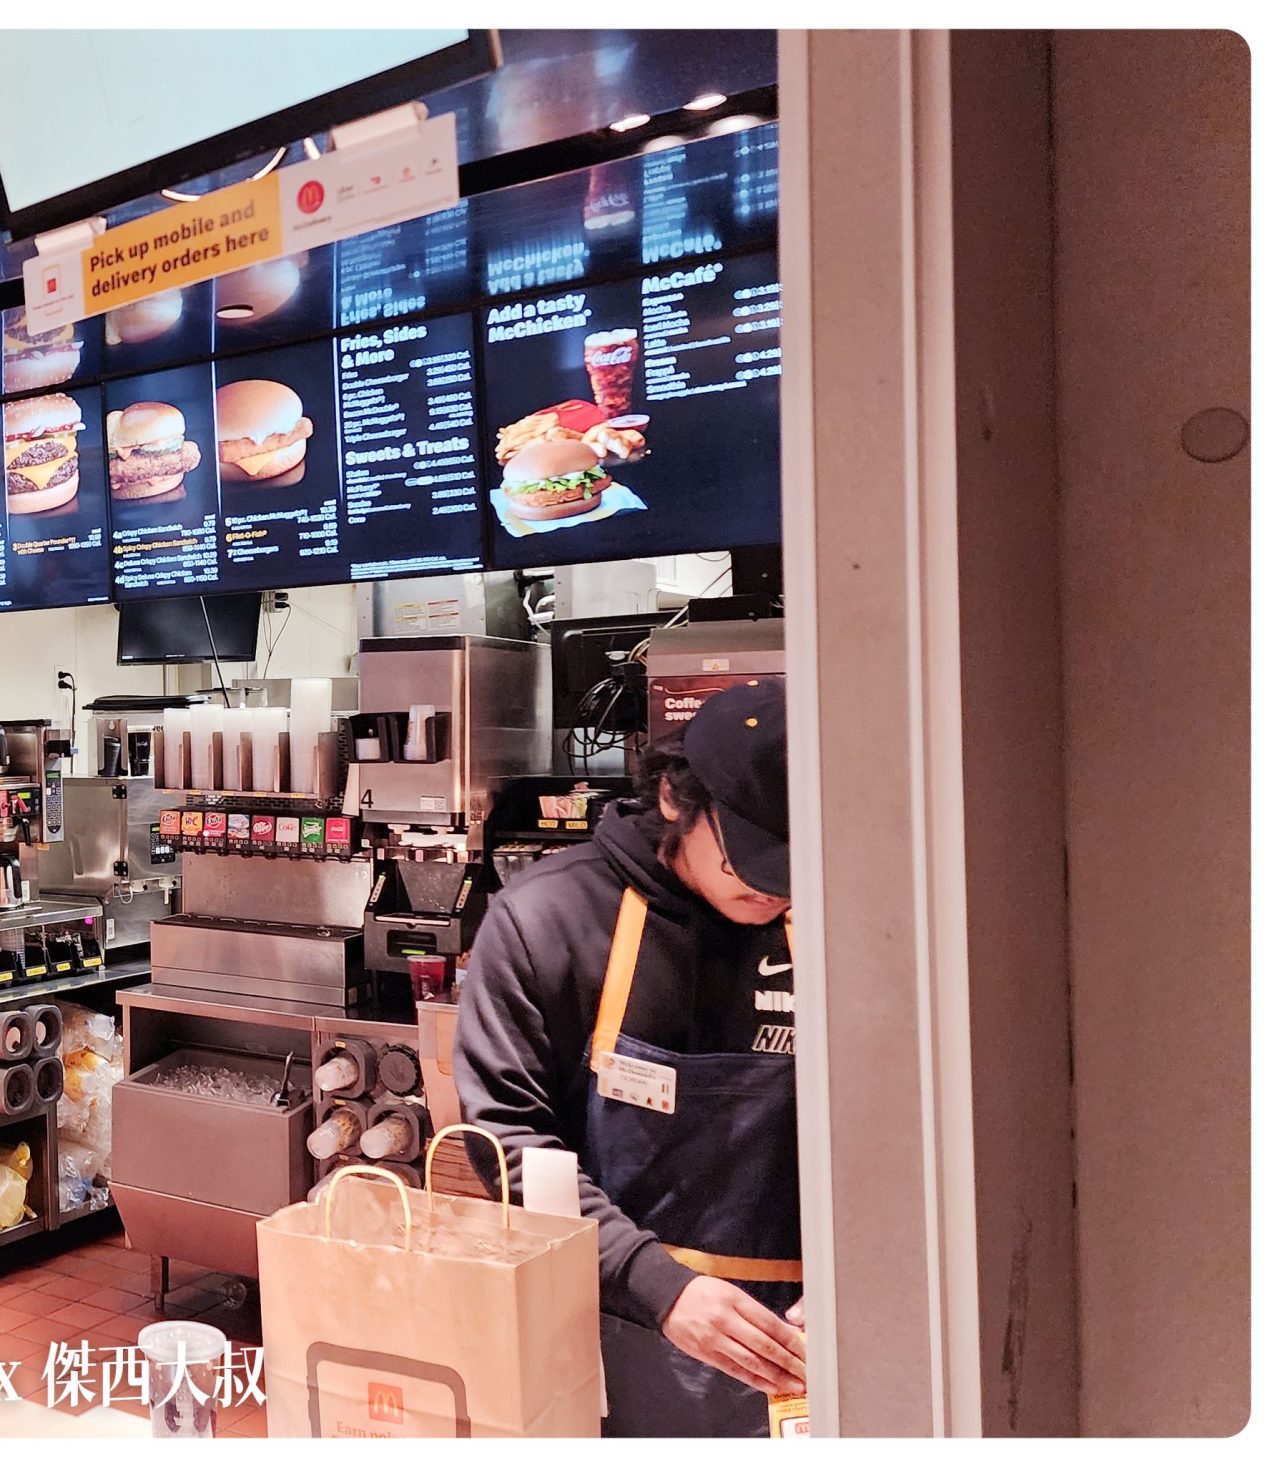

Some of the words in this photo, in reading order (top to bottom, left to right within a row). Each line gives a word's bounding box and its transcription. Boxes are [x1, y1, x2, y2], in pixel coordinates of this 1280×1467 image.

[90, 250, 125, 272] Pick
[129, 240, 149, 259] up
[153, 217, 214, 250] mobile
[219, 200, 256, 228] and
[92, 264, 158, 297] delivery
[162, 241, 221, 273] orders
[225, 227, 269, 253] here
[487, 303, 522, 325] Add
[523, 304, 536, 317] a
[537, 294, 586, 315] tasty
[341, 334, 383, 352] Fries,
[383, 326, 427, 344] Sides
[341, 355, 354, 369] &
[355, 349, 395, 367] More
[345, 446, 401, 465] Sweets
[402, 443, 416, 457] &
[416, 437, 469, 455] Treats
[665, 697, 705, 709] Coffe
[361, 789, 374, 808] 4
[755, 990, 795, 1012] NIK
[751, 1024, 796, 1055] NIK
[337, 1421, 366, 1438] Earn
